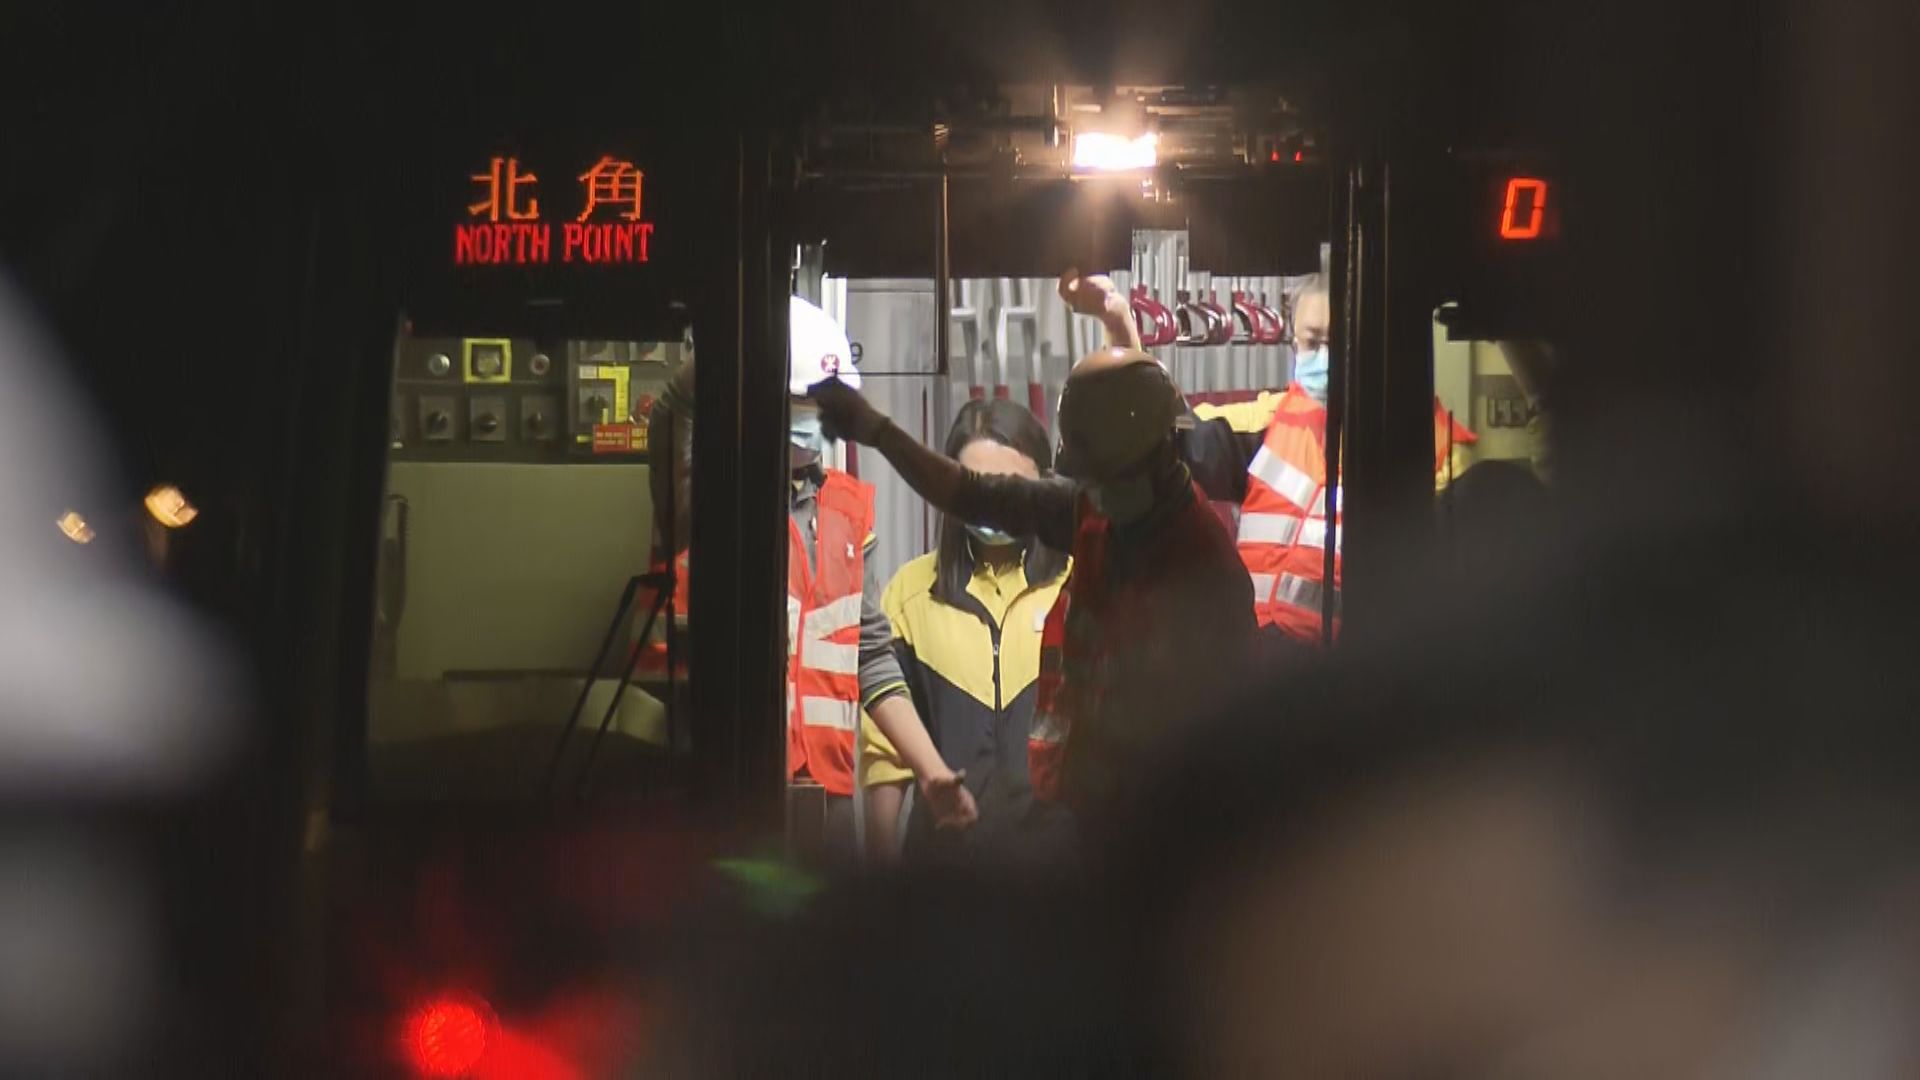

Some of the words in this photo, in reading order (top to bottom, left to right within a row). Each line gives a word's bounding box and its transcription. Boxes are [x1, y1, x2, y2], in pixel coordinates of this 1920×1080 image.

[467, 156, 644, 222] 北角
[1501, 178, 1546, 238] 0
[455, 223, 550, 264] NORTH
[563, 223, 654, 262] POINT
